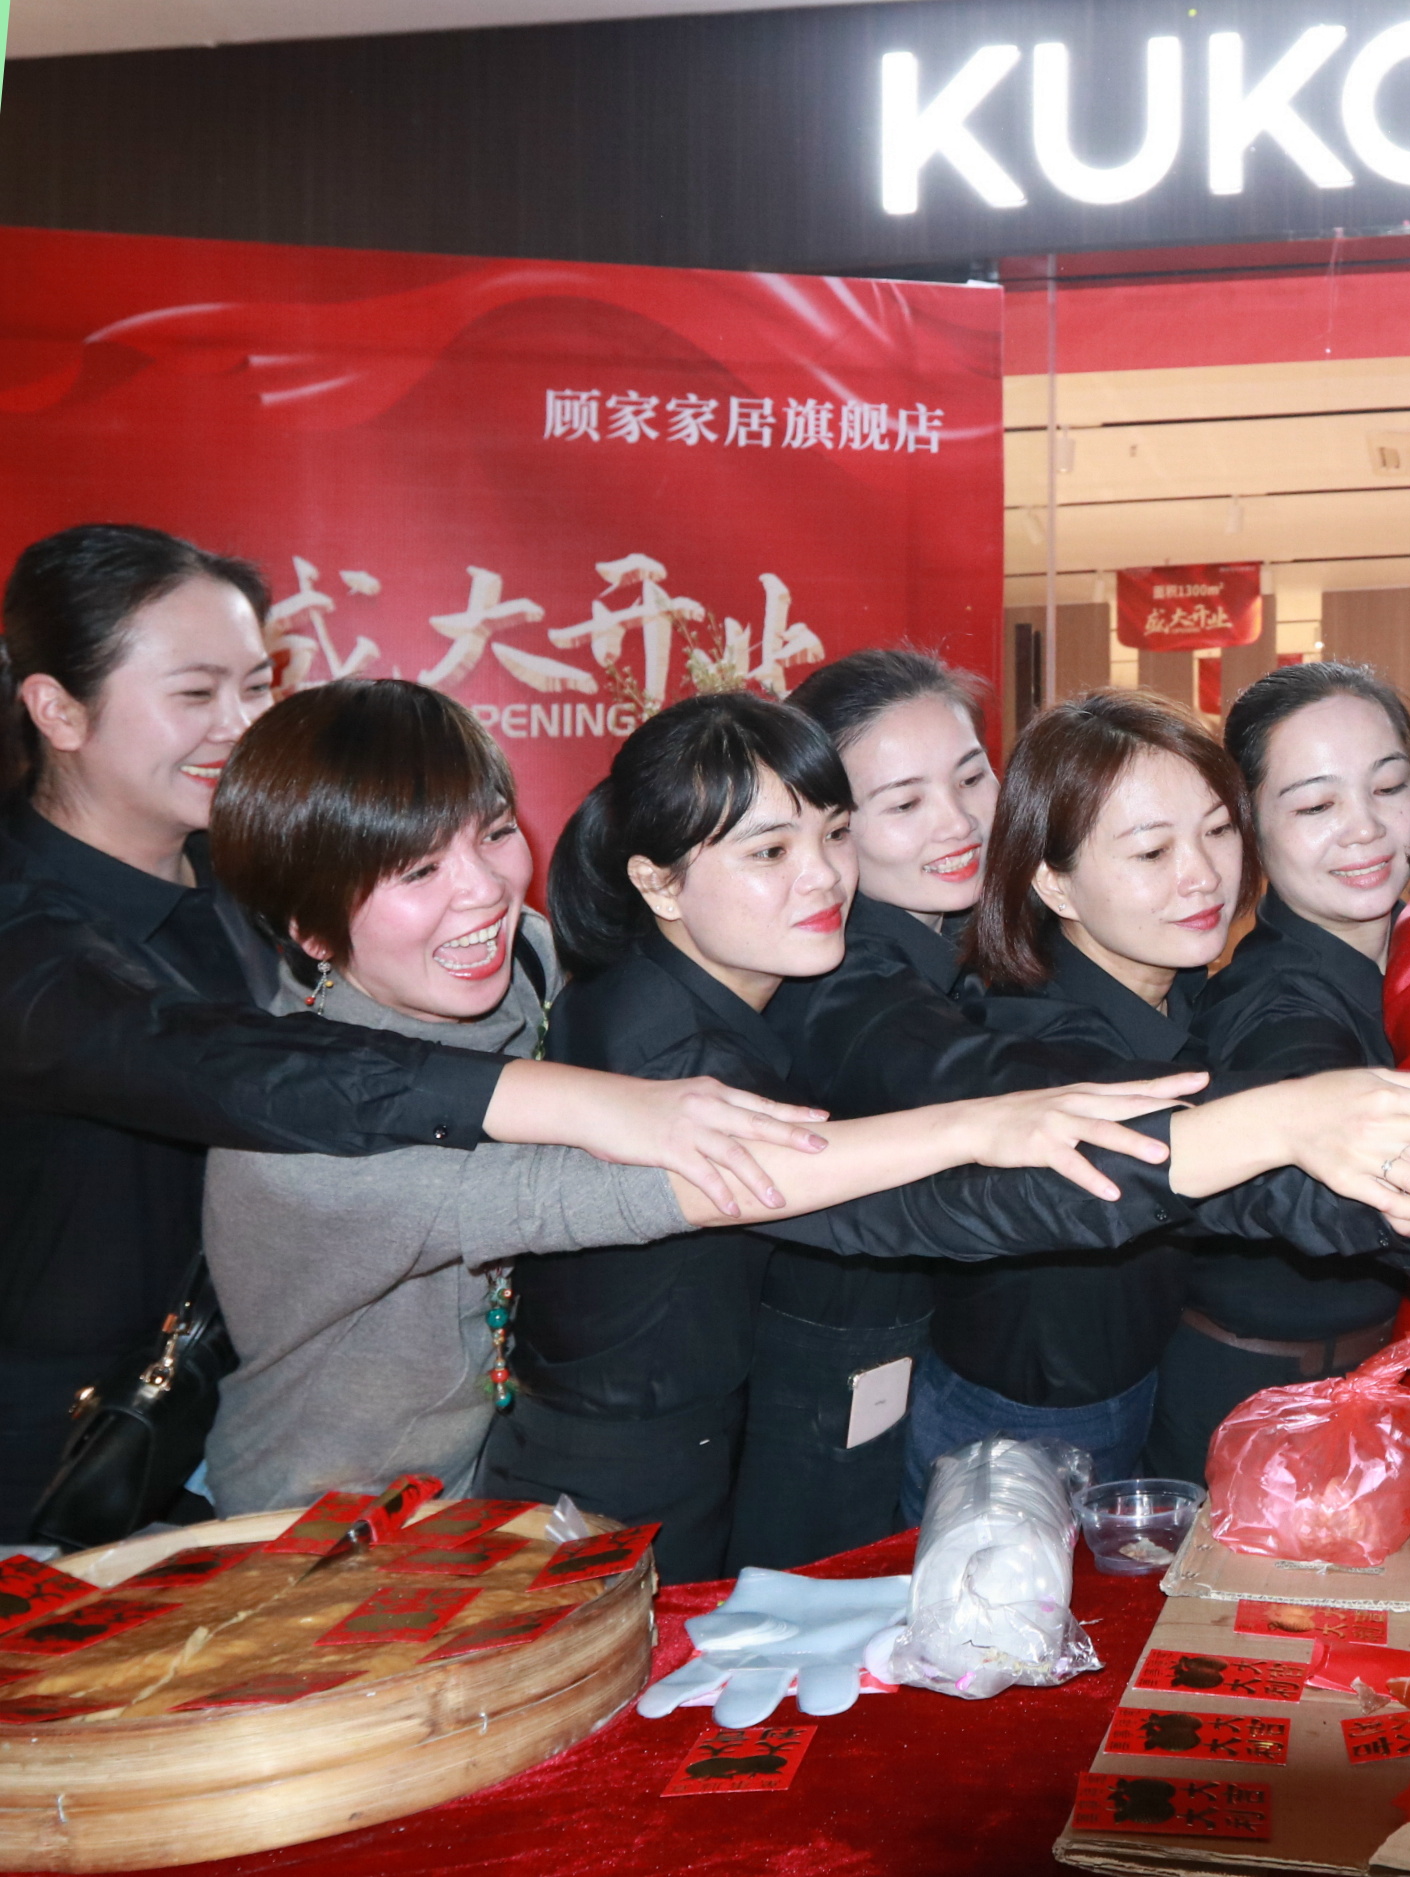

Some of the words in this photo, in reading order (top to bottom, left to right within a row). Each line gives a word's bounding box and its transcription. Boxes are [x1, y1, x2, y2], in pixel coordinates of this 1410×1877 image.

[543, 388, 945, 454] 顾家家居旗舰店
[470, 703, 636, 738] PENING
